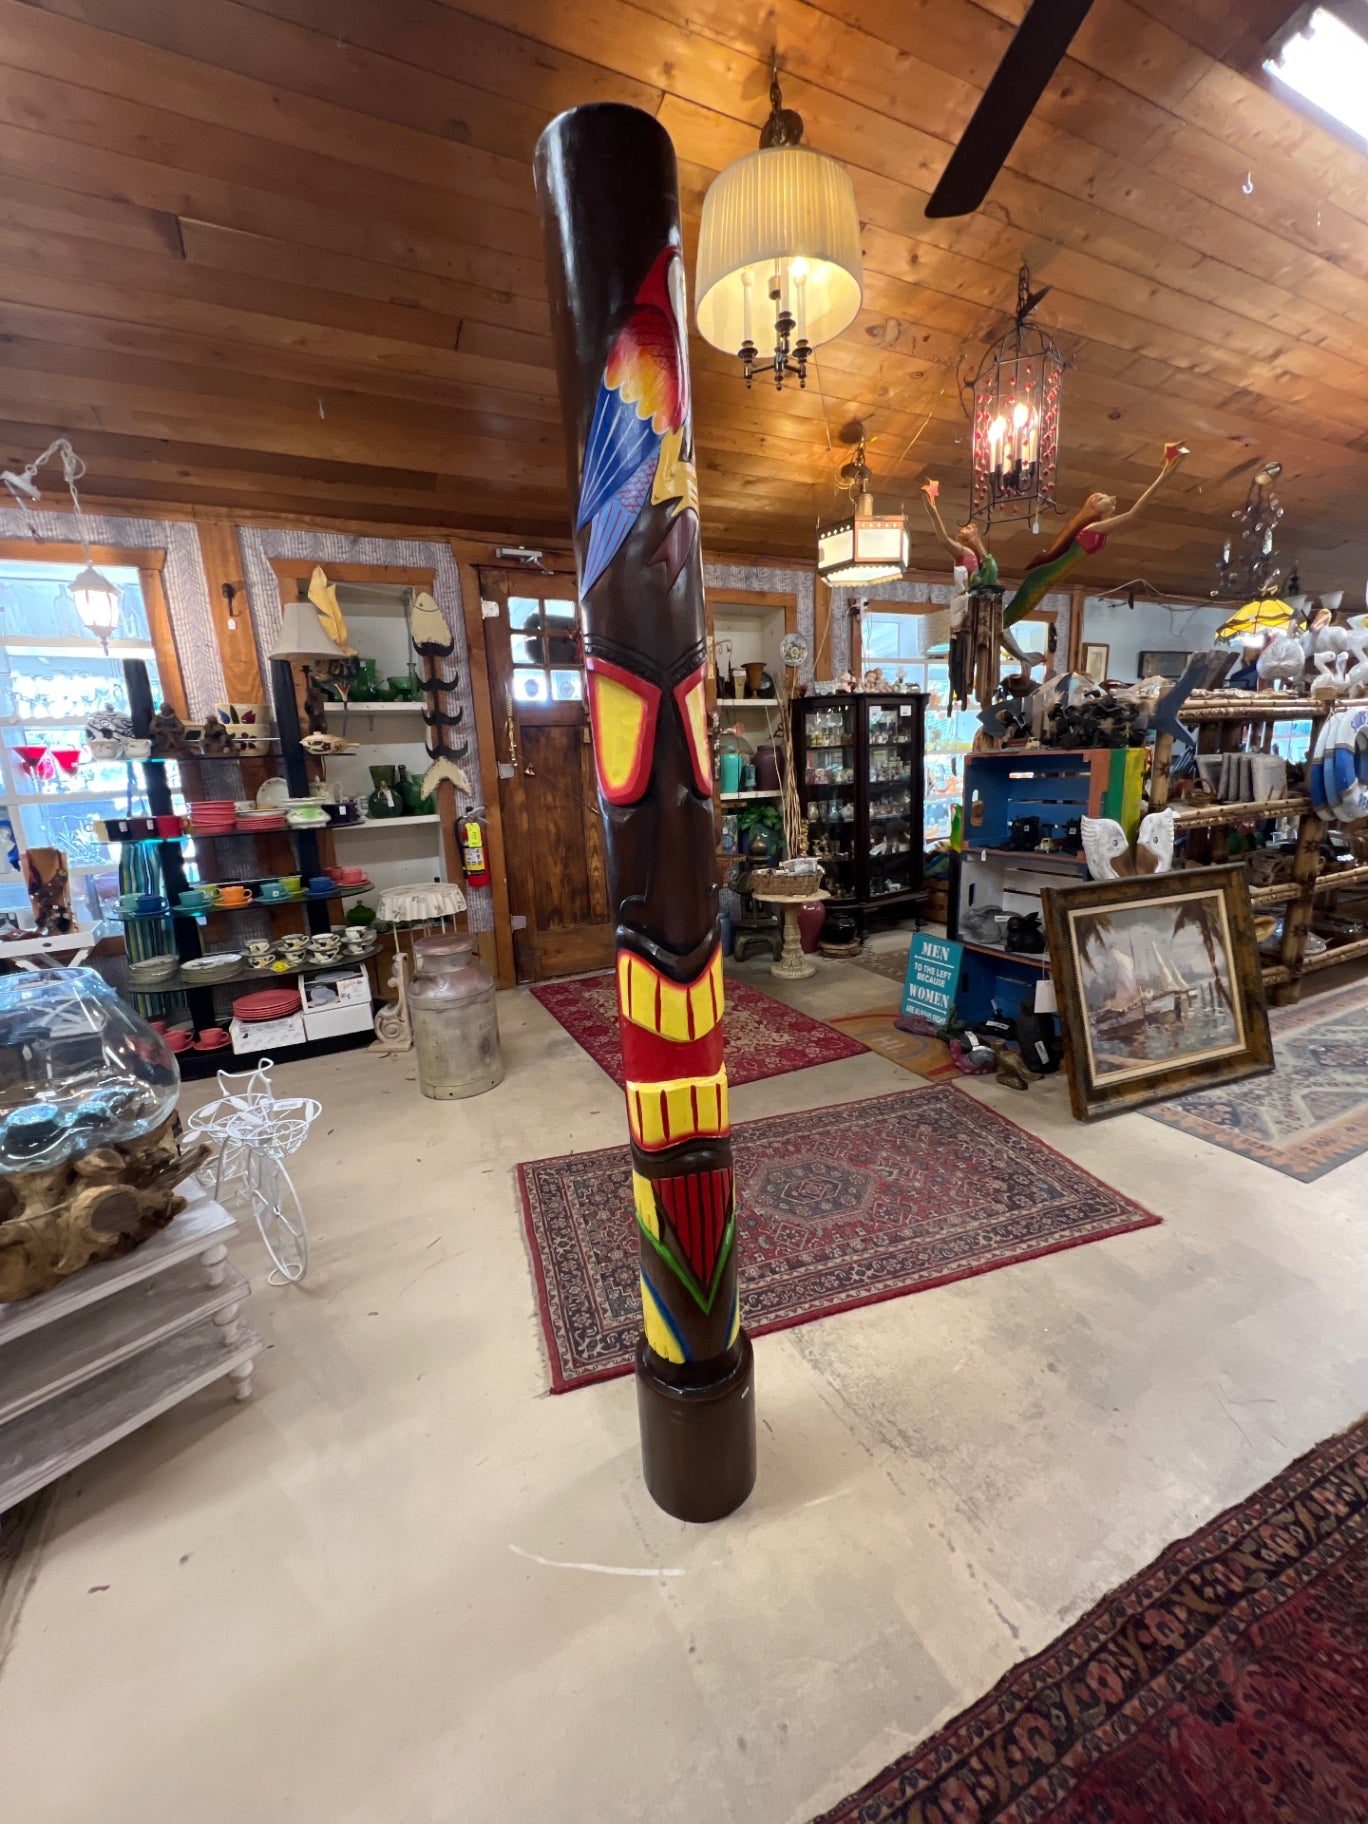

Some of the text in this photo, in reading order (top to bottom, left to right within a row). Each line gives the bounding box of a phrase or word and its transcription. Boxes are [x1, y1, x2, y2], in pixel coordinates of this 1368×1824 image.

[921, 942, 950, 961] MEN
[914, 962, 952, 980] TO THE LEFT
[916, 972, 946, 988] BECAUSE
[909, 983, 950, 1009] WOMEN
